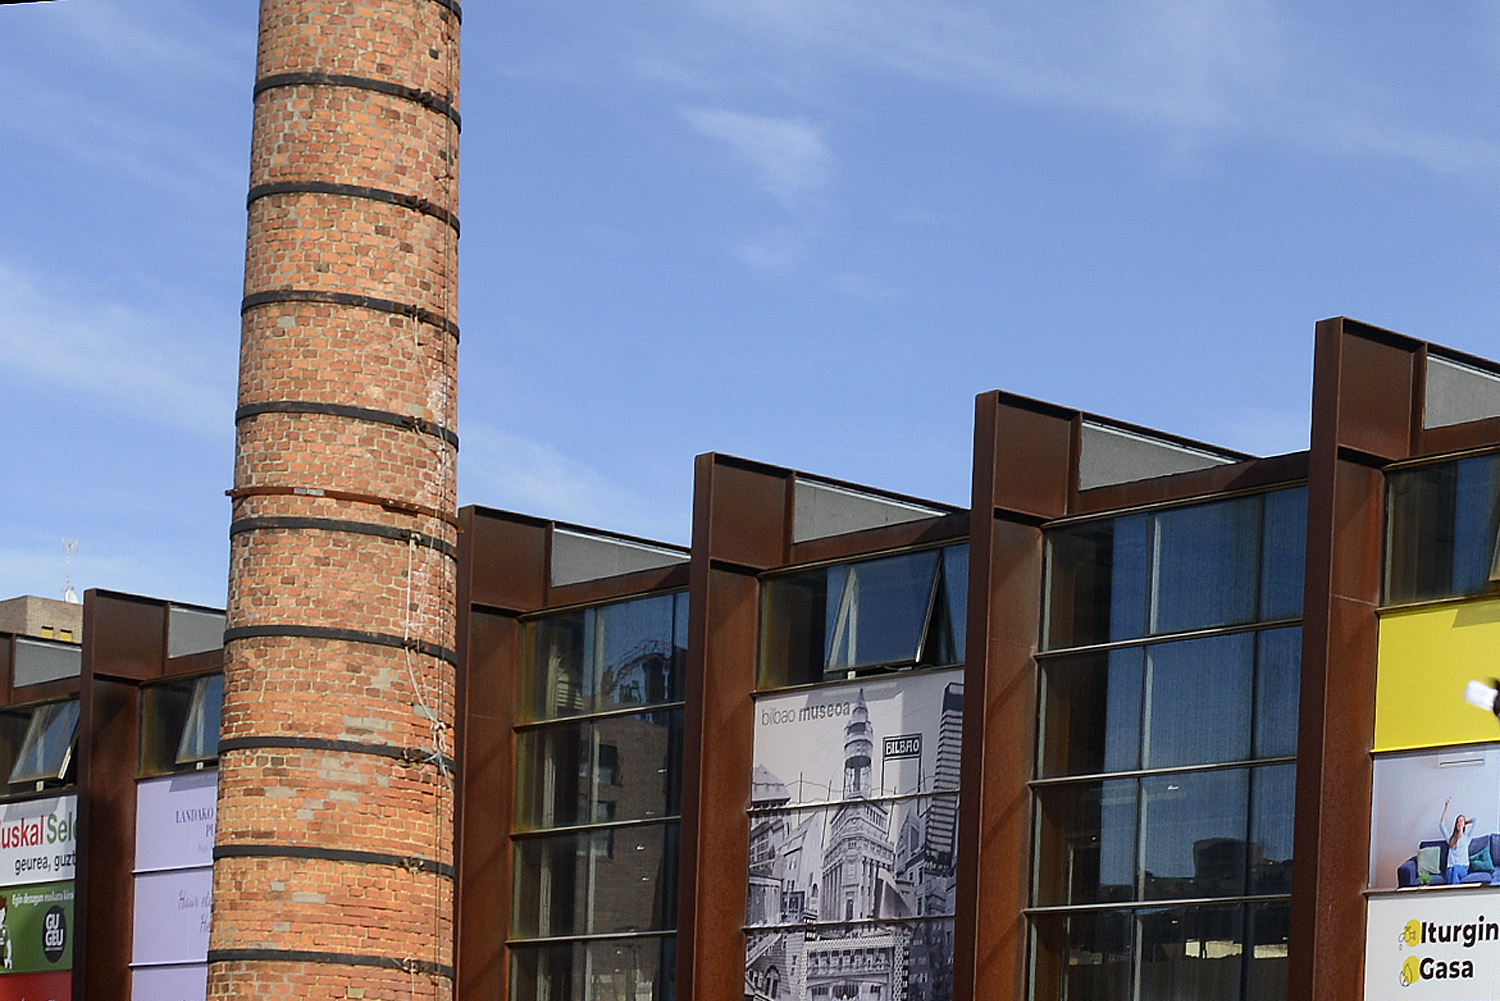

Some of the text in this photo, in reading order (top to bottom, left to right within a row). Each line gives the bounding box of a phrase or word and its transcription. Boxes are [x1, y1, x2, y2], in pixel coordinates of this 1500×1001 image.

[761, 701, 850, 726] bilbao museoa
[885, 739, 921, 755] BILBAO
[175, 806, 214, 823] LANDAKO
[0, 815, 44, 849] uskal
[15, 856, 51, 876] geurea,
[1419, 957, 1474, 980] Gasa
